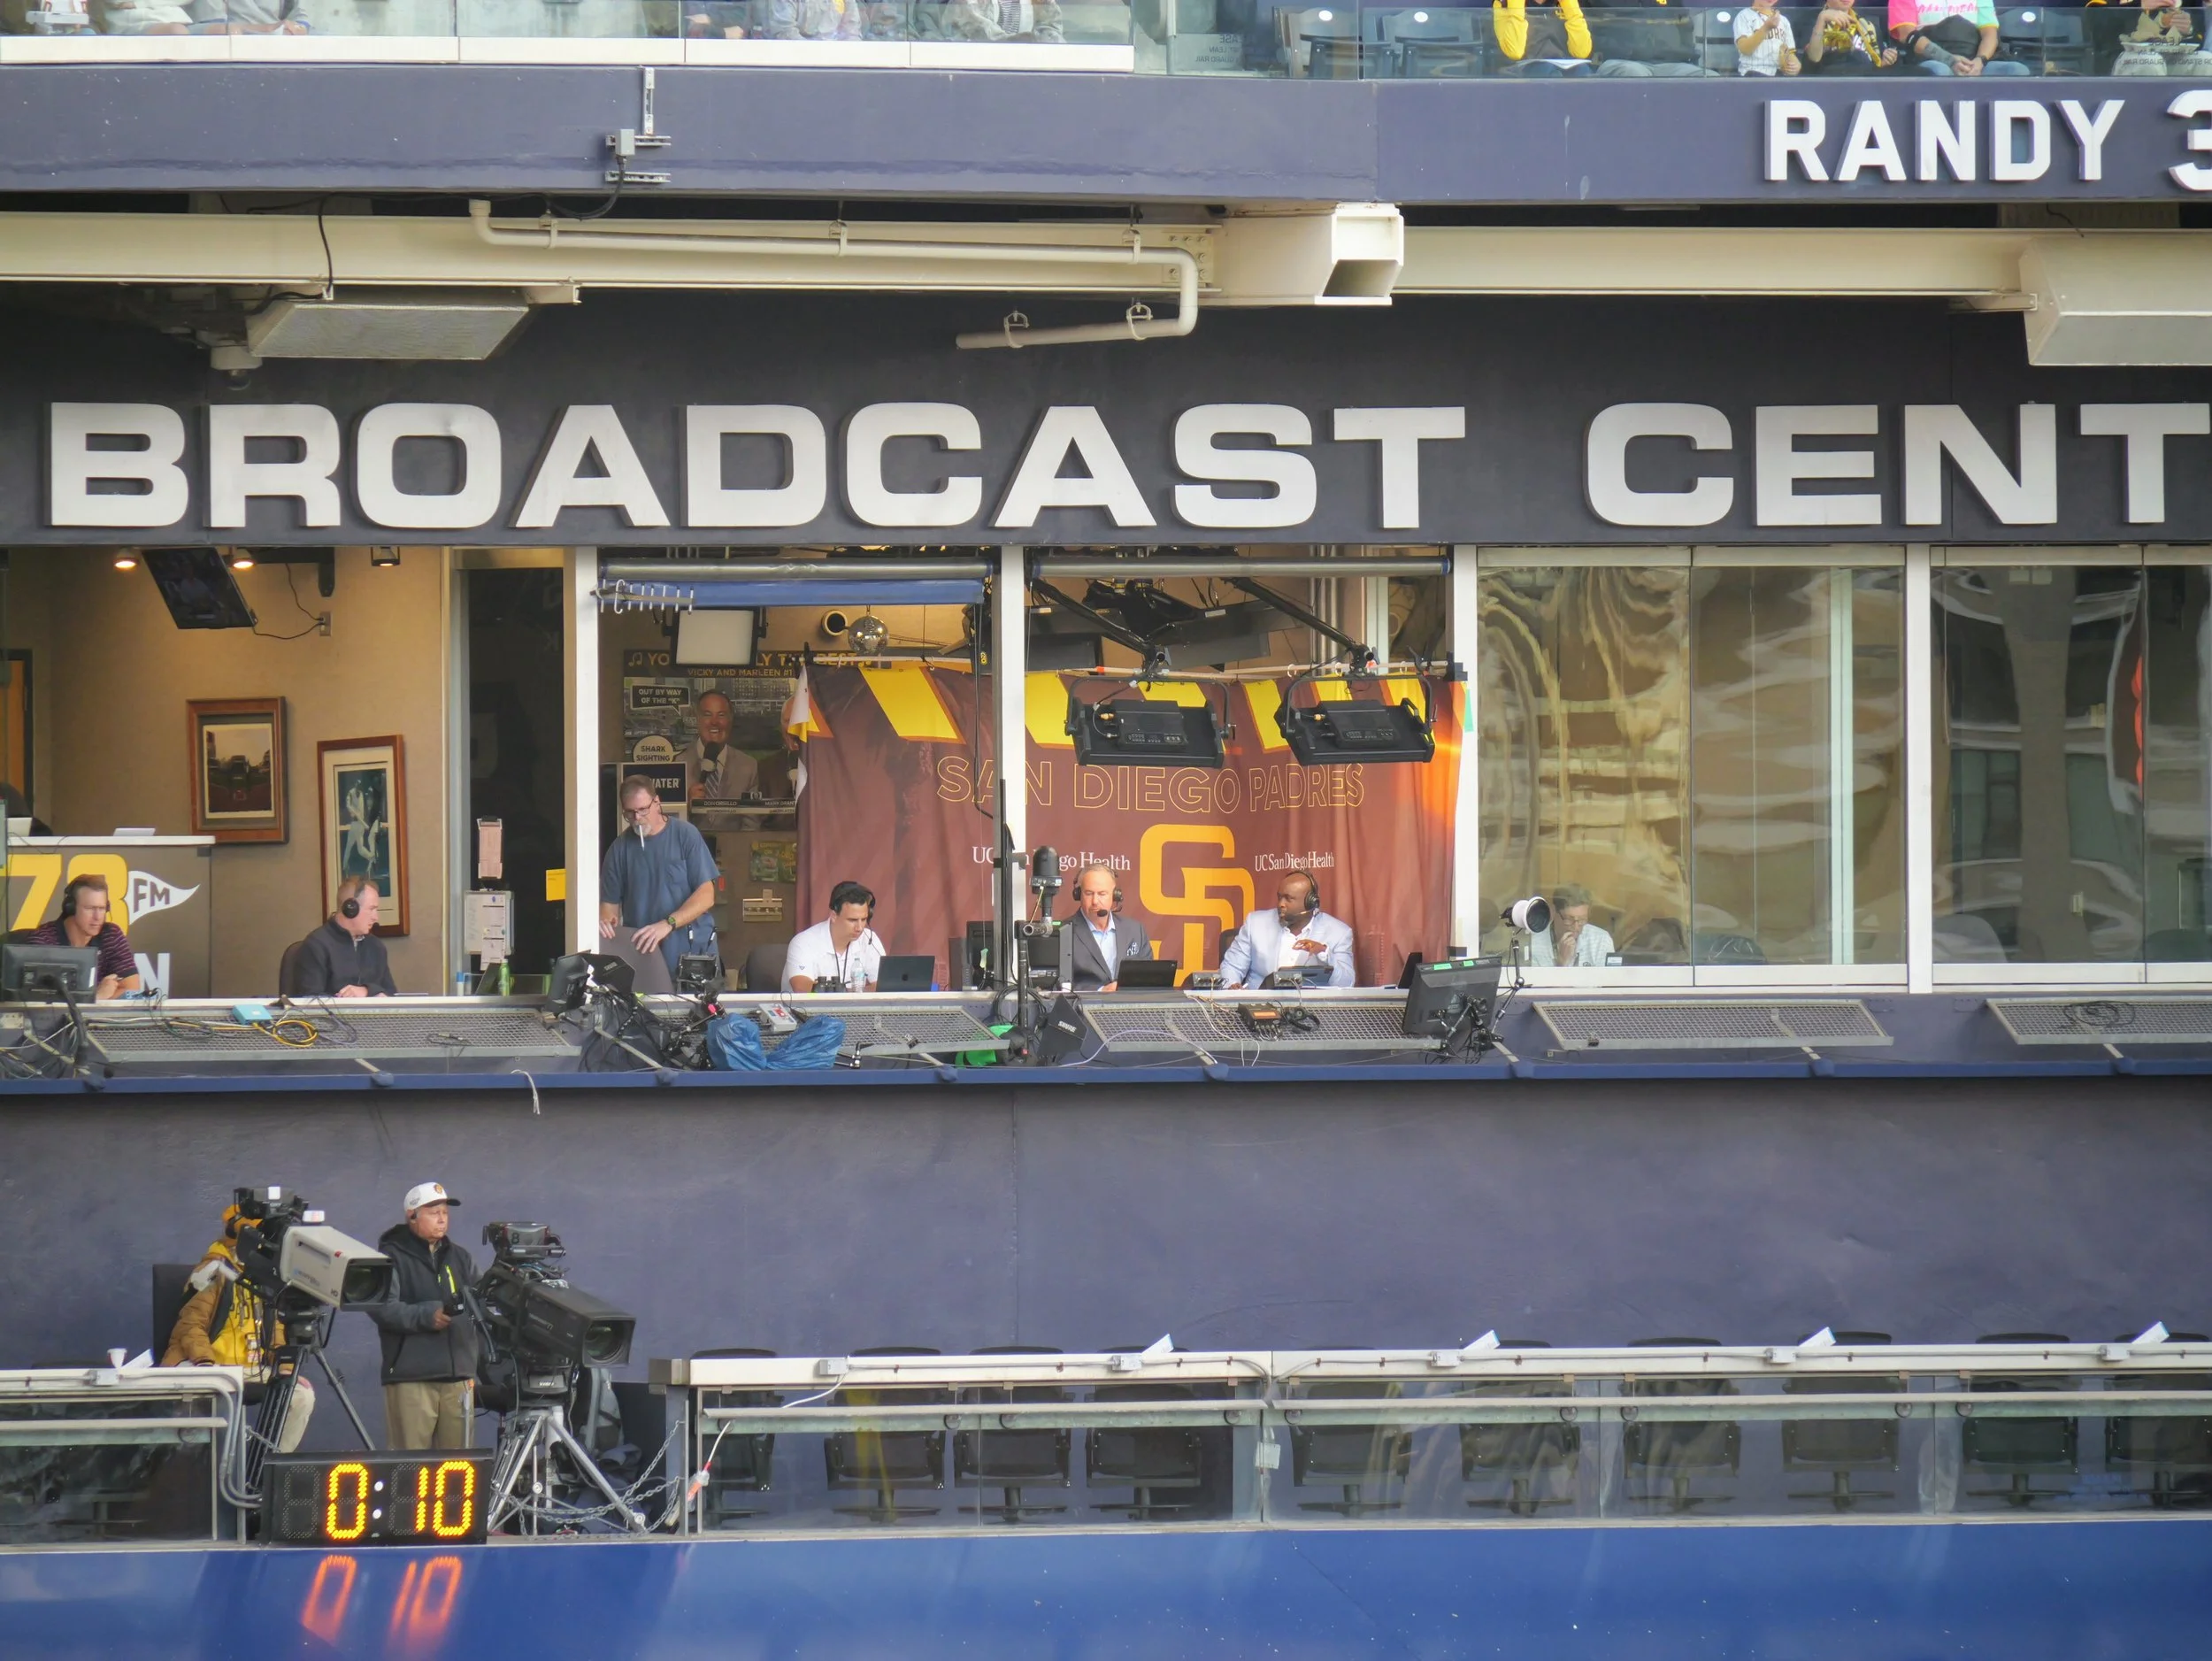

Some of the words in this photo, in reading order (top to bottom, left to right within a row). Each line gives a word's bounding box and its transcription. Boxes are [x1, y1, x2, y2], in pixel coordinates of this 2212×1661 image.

[1764, 99, 2125, 181] RANDY
[2166, 89, 2212, 191] 3
[50, 402, 1465, 527] BROADCAST
[1586, 402, 2211, 526] CENT
[1074, 764, 1240, 814] DIEGO
[1248, 762, 1364, 812] PADRES
[1079, 851, 1131, 871] Health
[1255, 855, 1268, 872] UC
[1268, 854, 1285, 871] San
[1285, 852, 1308, 872] Diego
[1308, 850, 1335, 868] Health
[133, 877, 171, 914] FM
[511, 1232, 520, 1244] 8
[326, 1460, 476, 1541] 0:10
